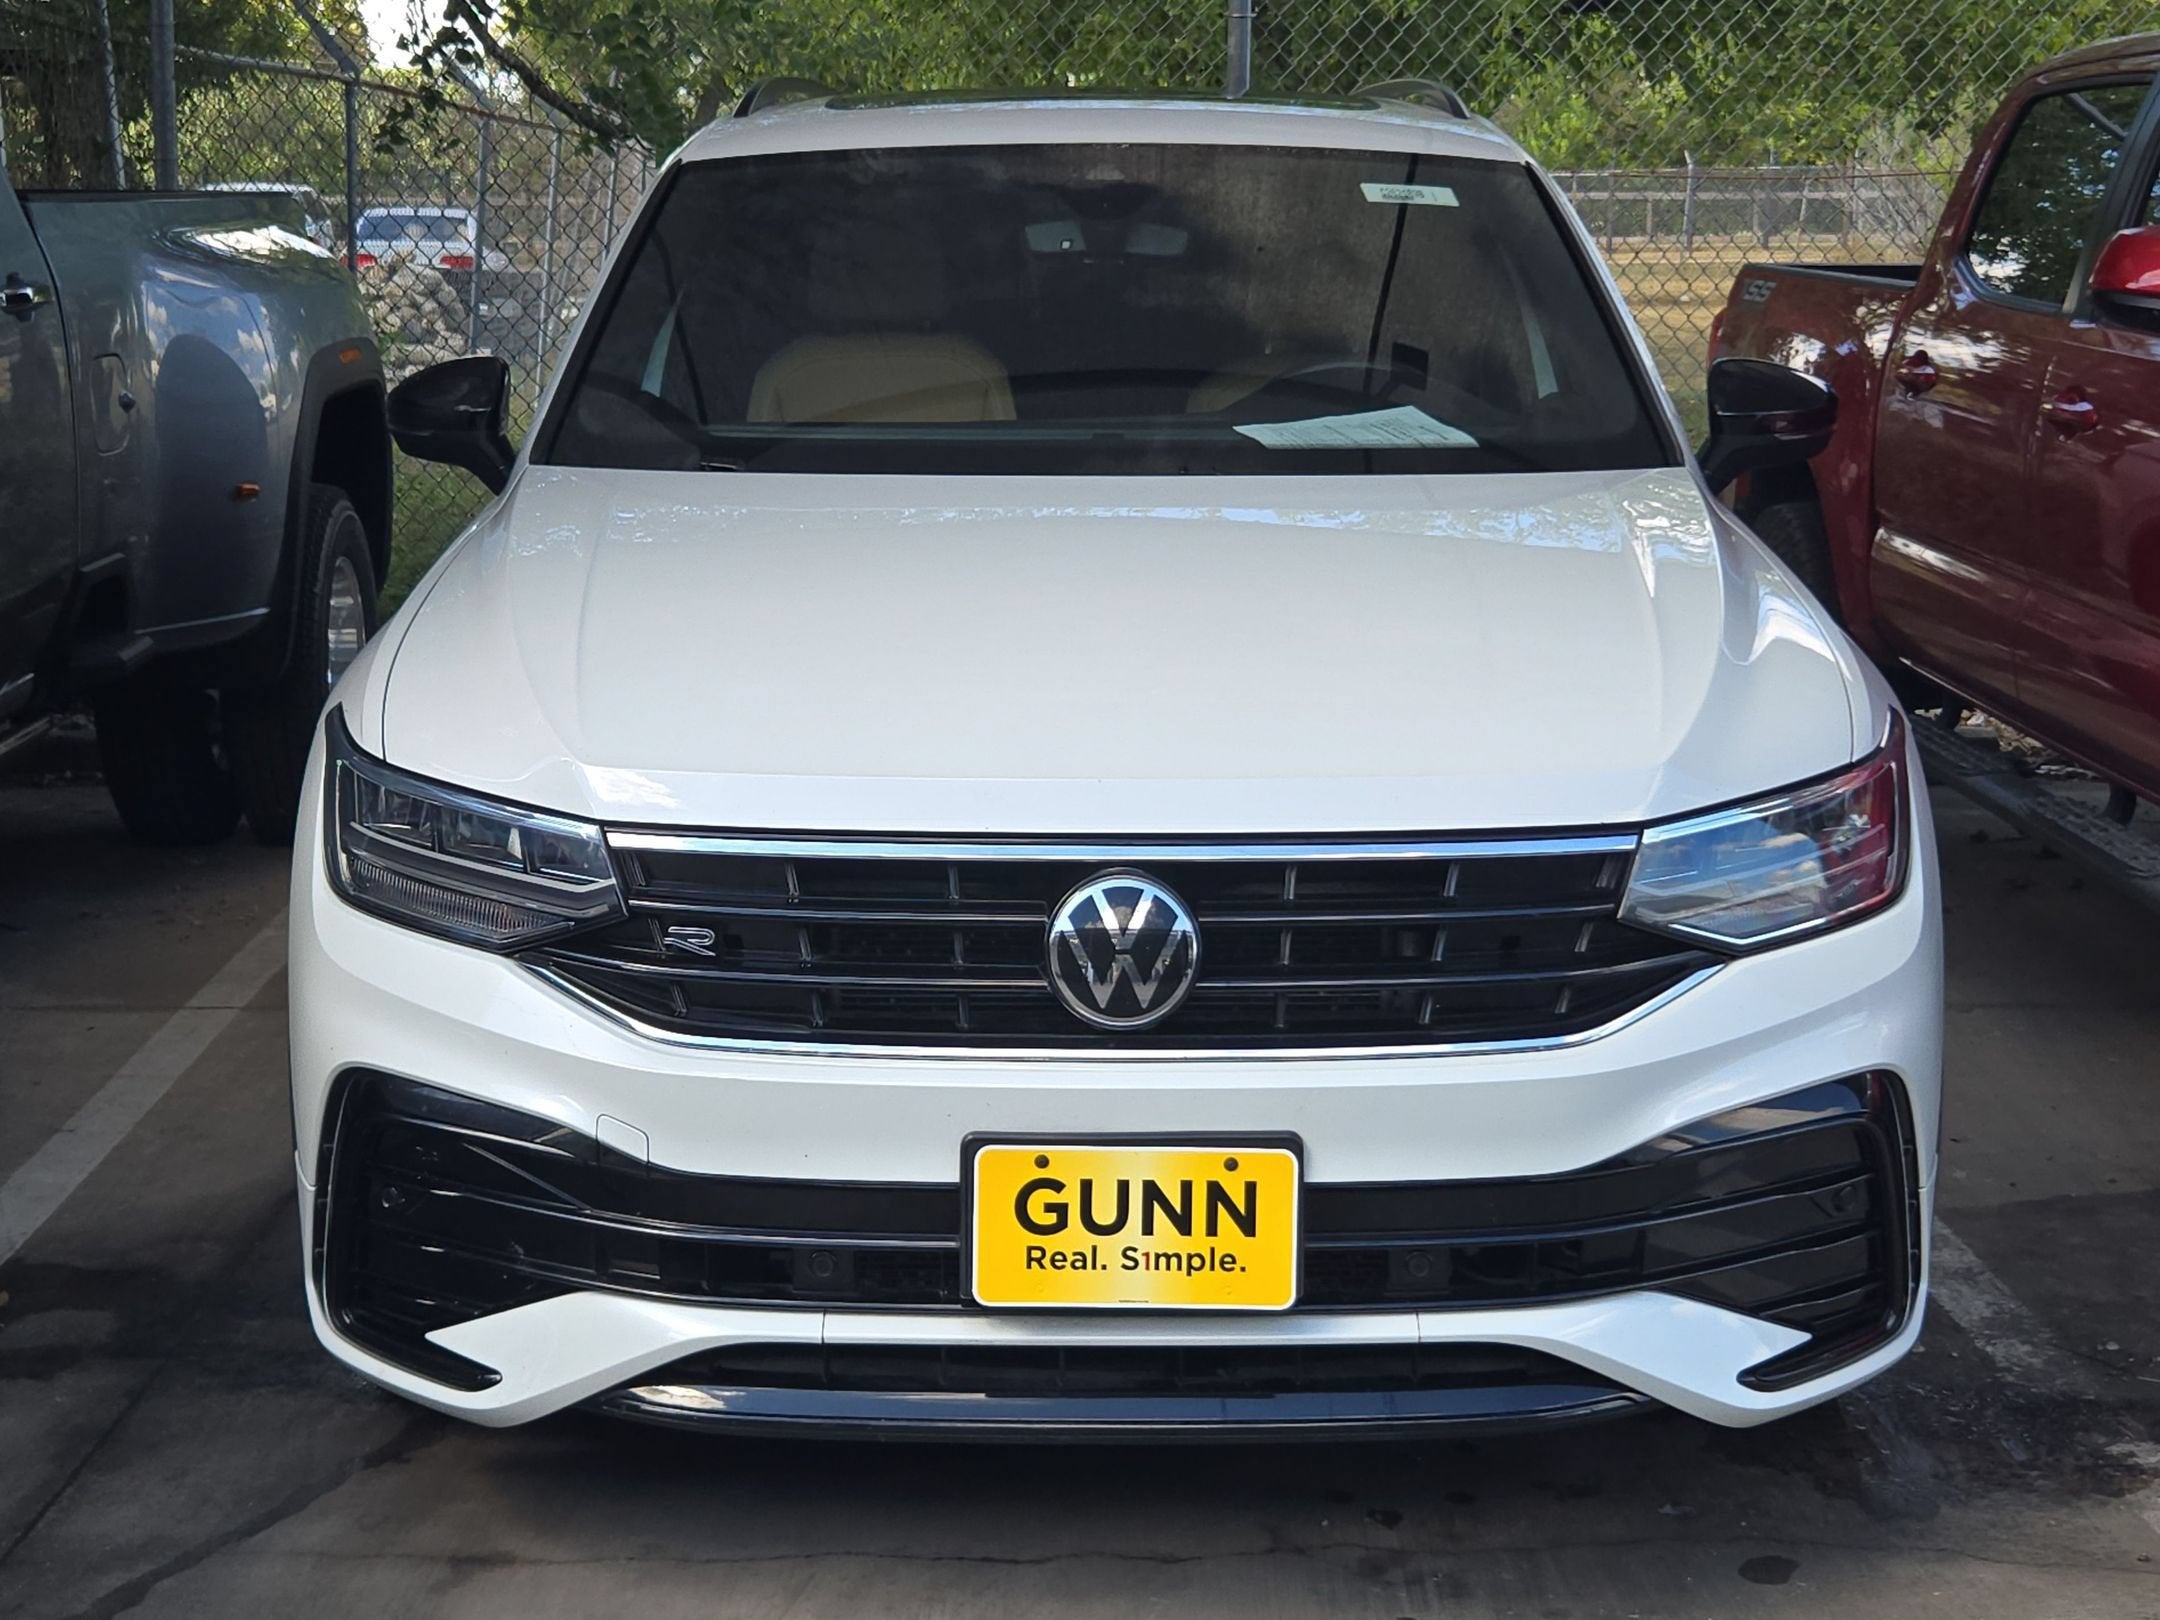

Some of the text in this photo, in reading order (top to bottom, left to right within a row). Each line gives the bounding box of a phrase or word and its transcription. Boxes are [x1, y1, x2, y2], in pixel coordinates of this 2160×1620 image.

[663, 926, 716, 956] R
[1055, 877, 1190, 1012] VW
[1014, 1177, 1257, 1237] GUNN
[1025, 1244, 1108, 1270] Real.
